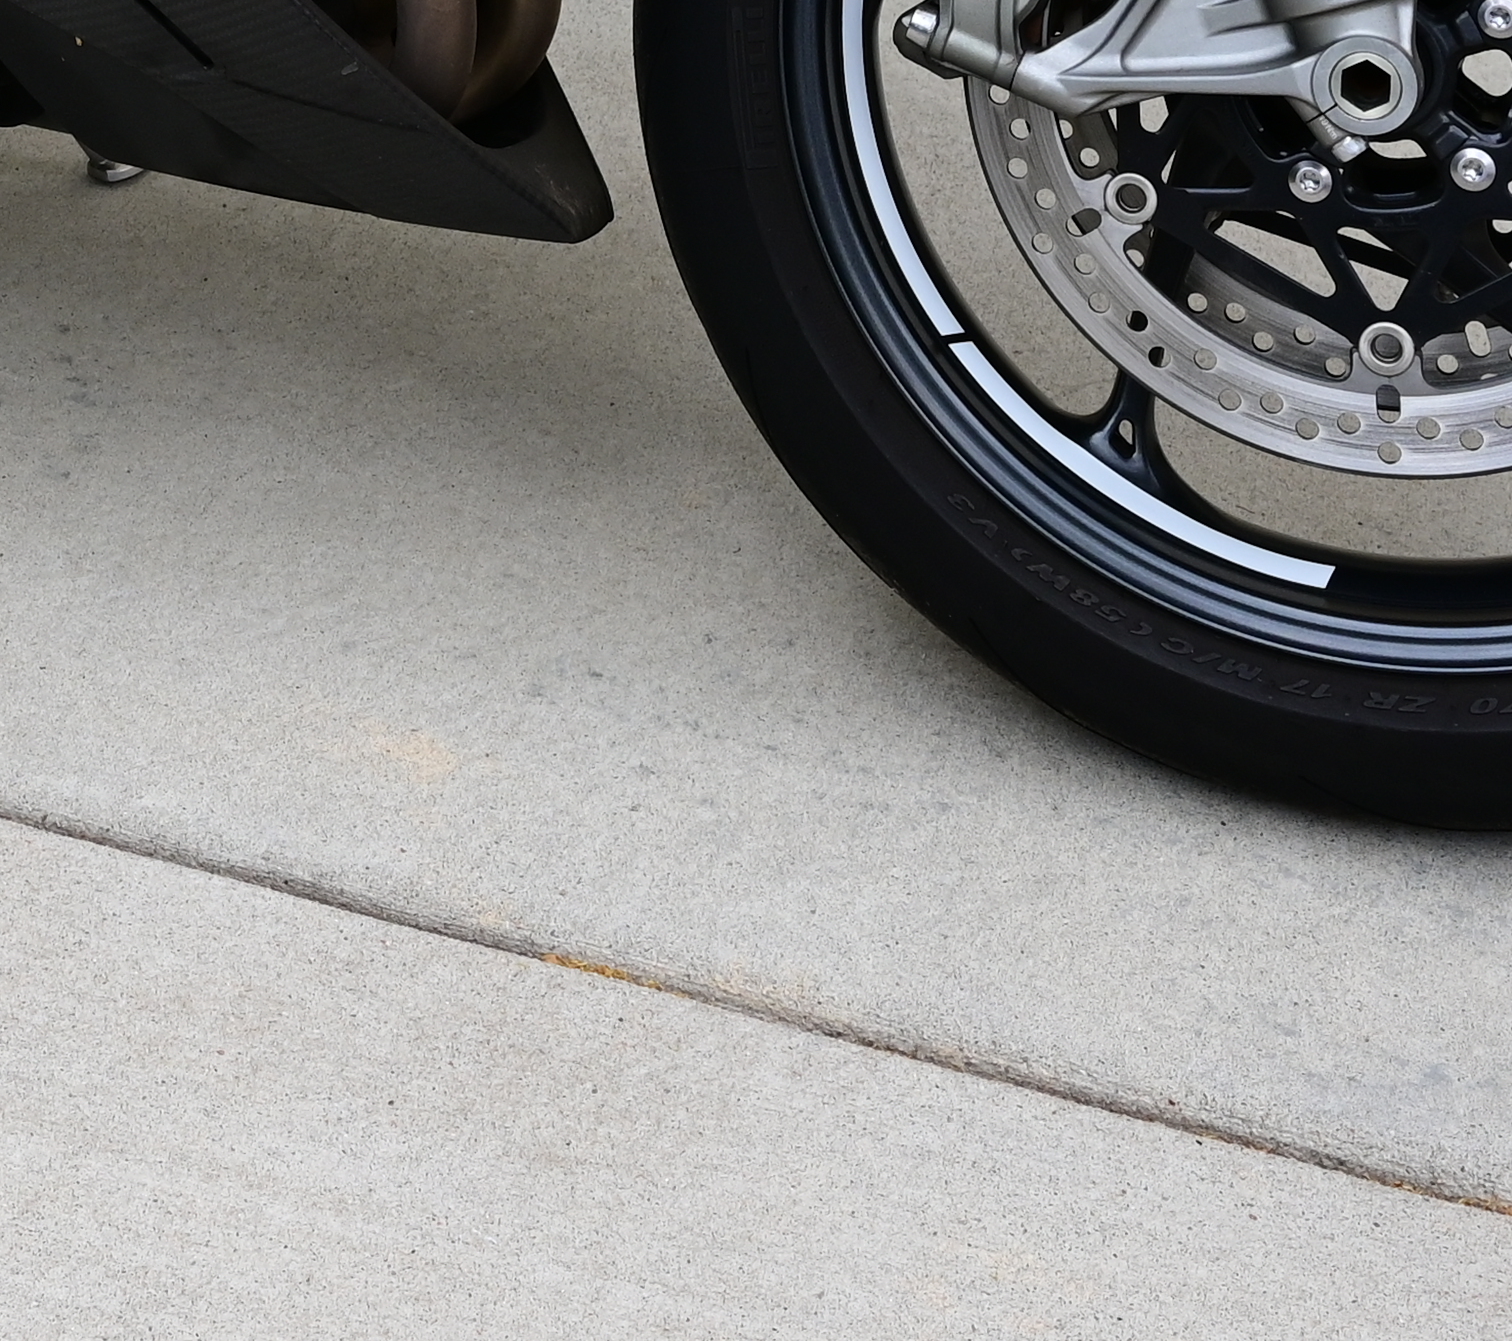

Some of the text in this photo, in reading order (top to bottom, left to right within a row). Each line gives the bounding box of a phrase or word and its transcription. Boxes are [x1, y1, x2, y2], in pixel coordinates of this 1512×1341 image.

[1159, 637, 1263, 682] M/C
[1278, 677, 1333, 700] 17
[1362, 691, 1437, 714] ZR
